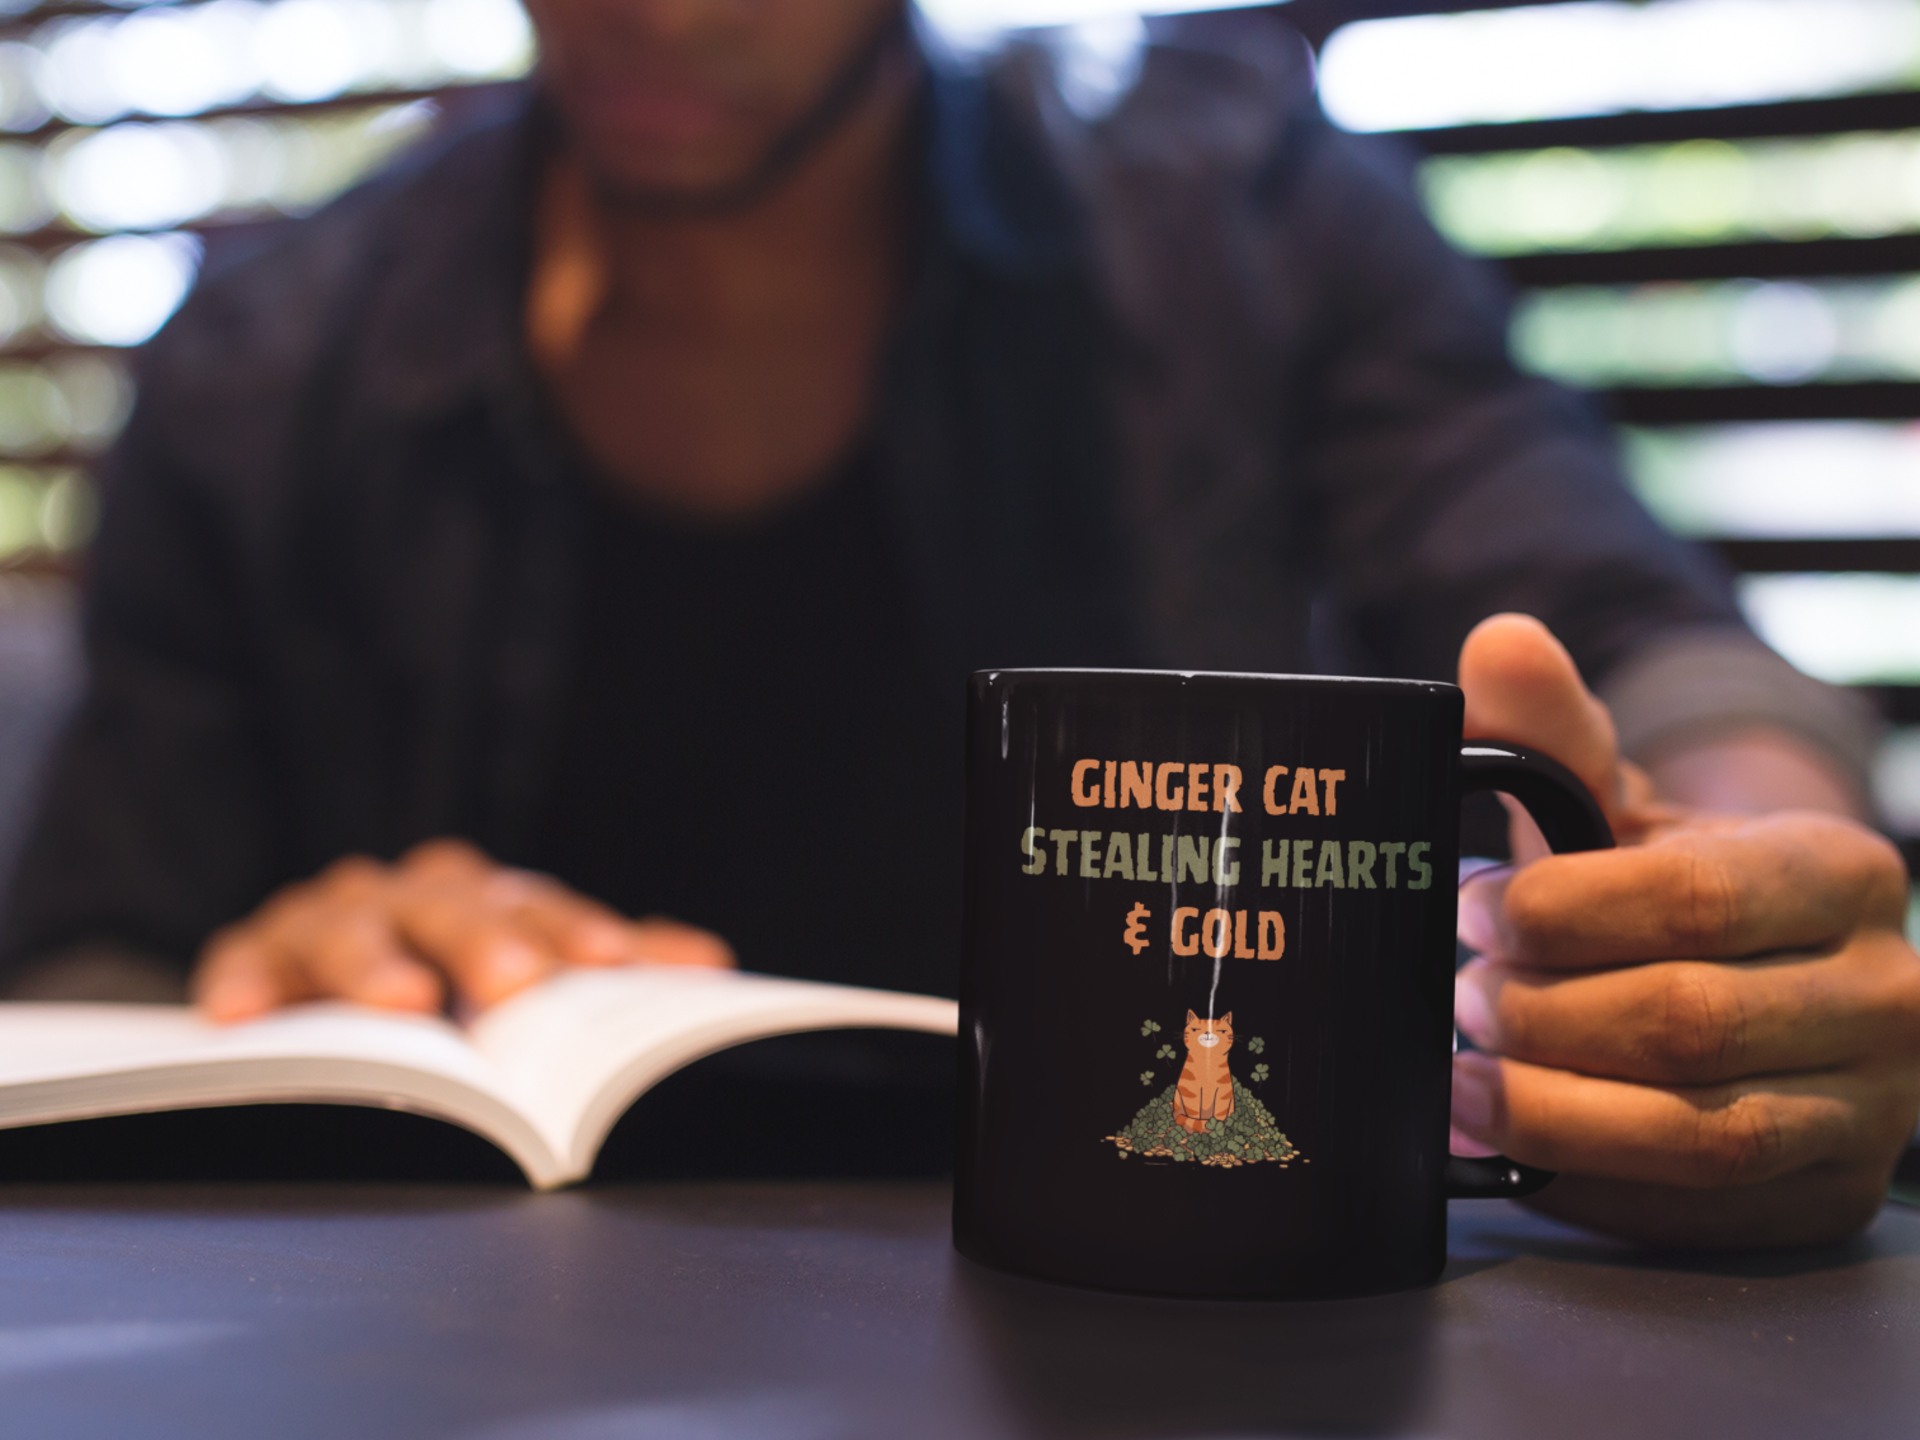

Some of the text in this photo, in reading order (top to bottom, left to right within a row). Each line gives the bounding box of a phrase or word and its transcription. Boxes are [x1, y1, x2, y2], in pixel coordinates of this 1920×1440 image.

[1070, 758, 1347, 816] GINGER CAT
[1020, 826, 1433, 890] STEALING HEARTS
[1123, 901, 1286, 961] & GOLD
